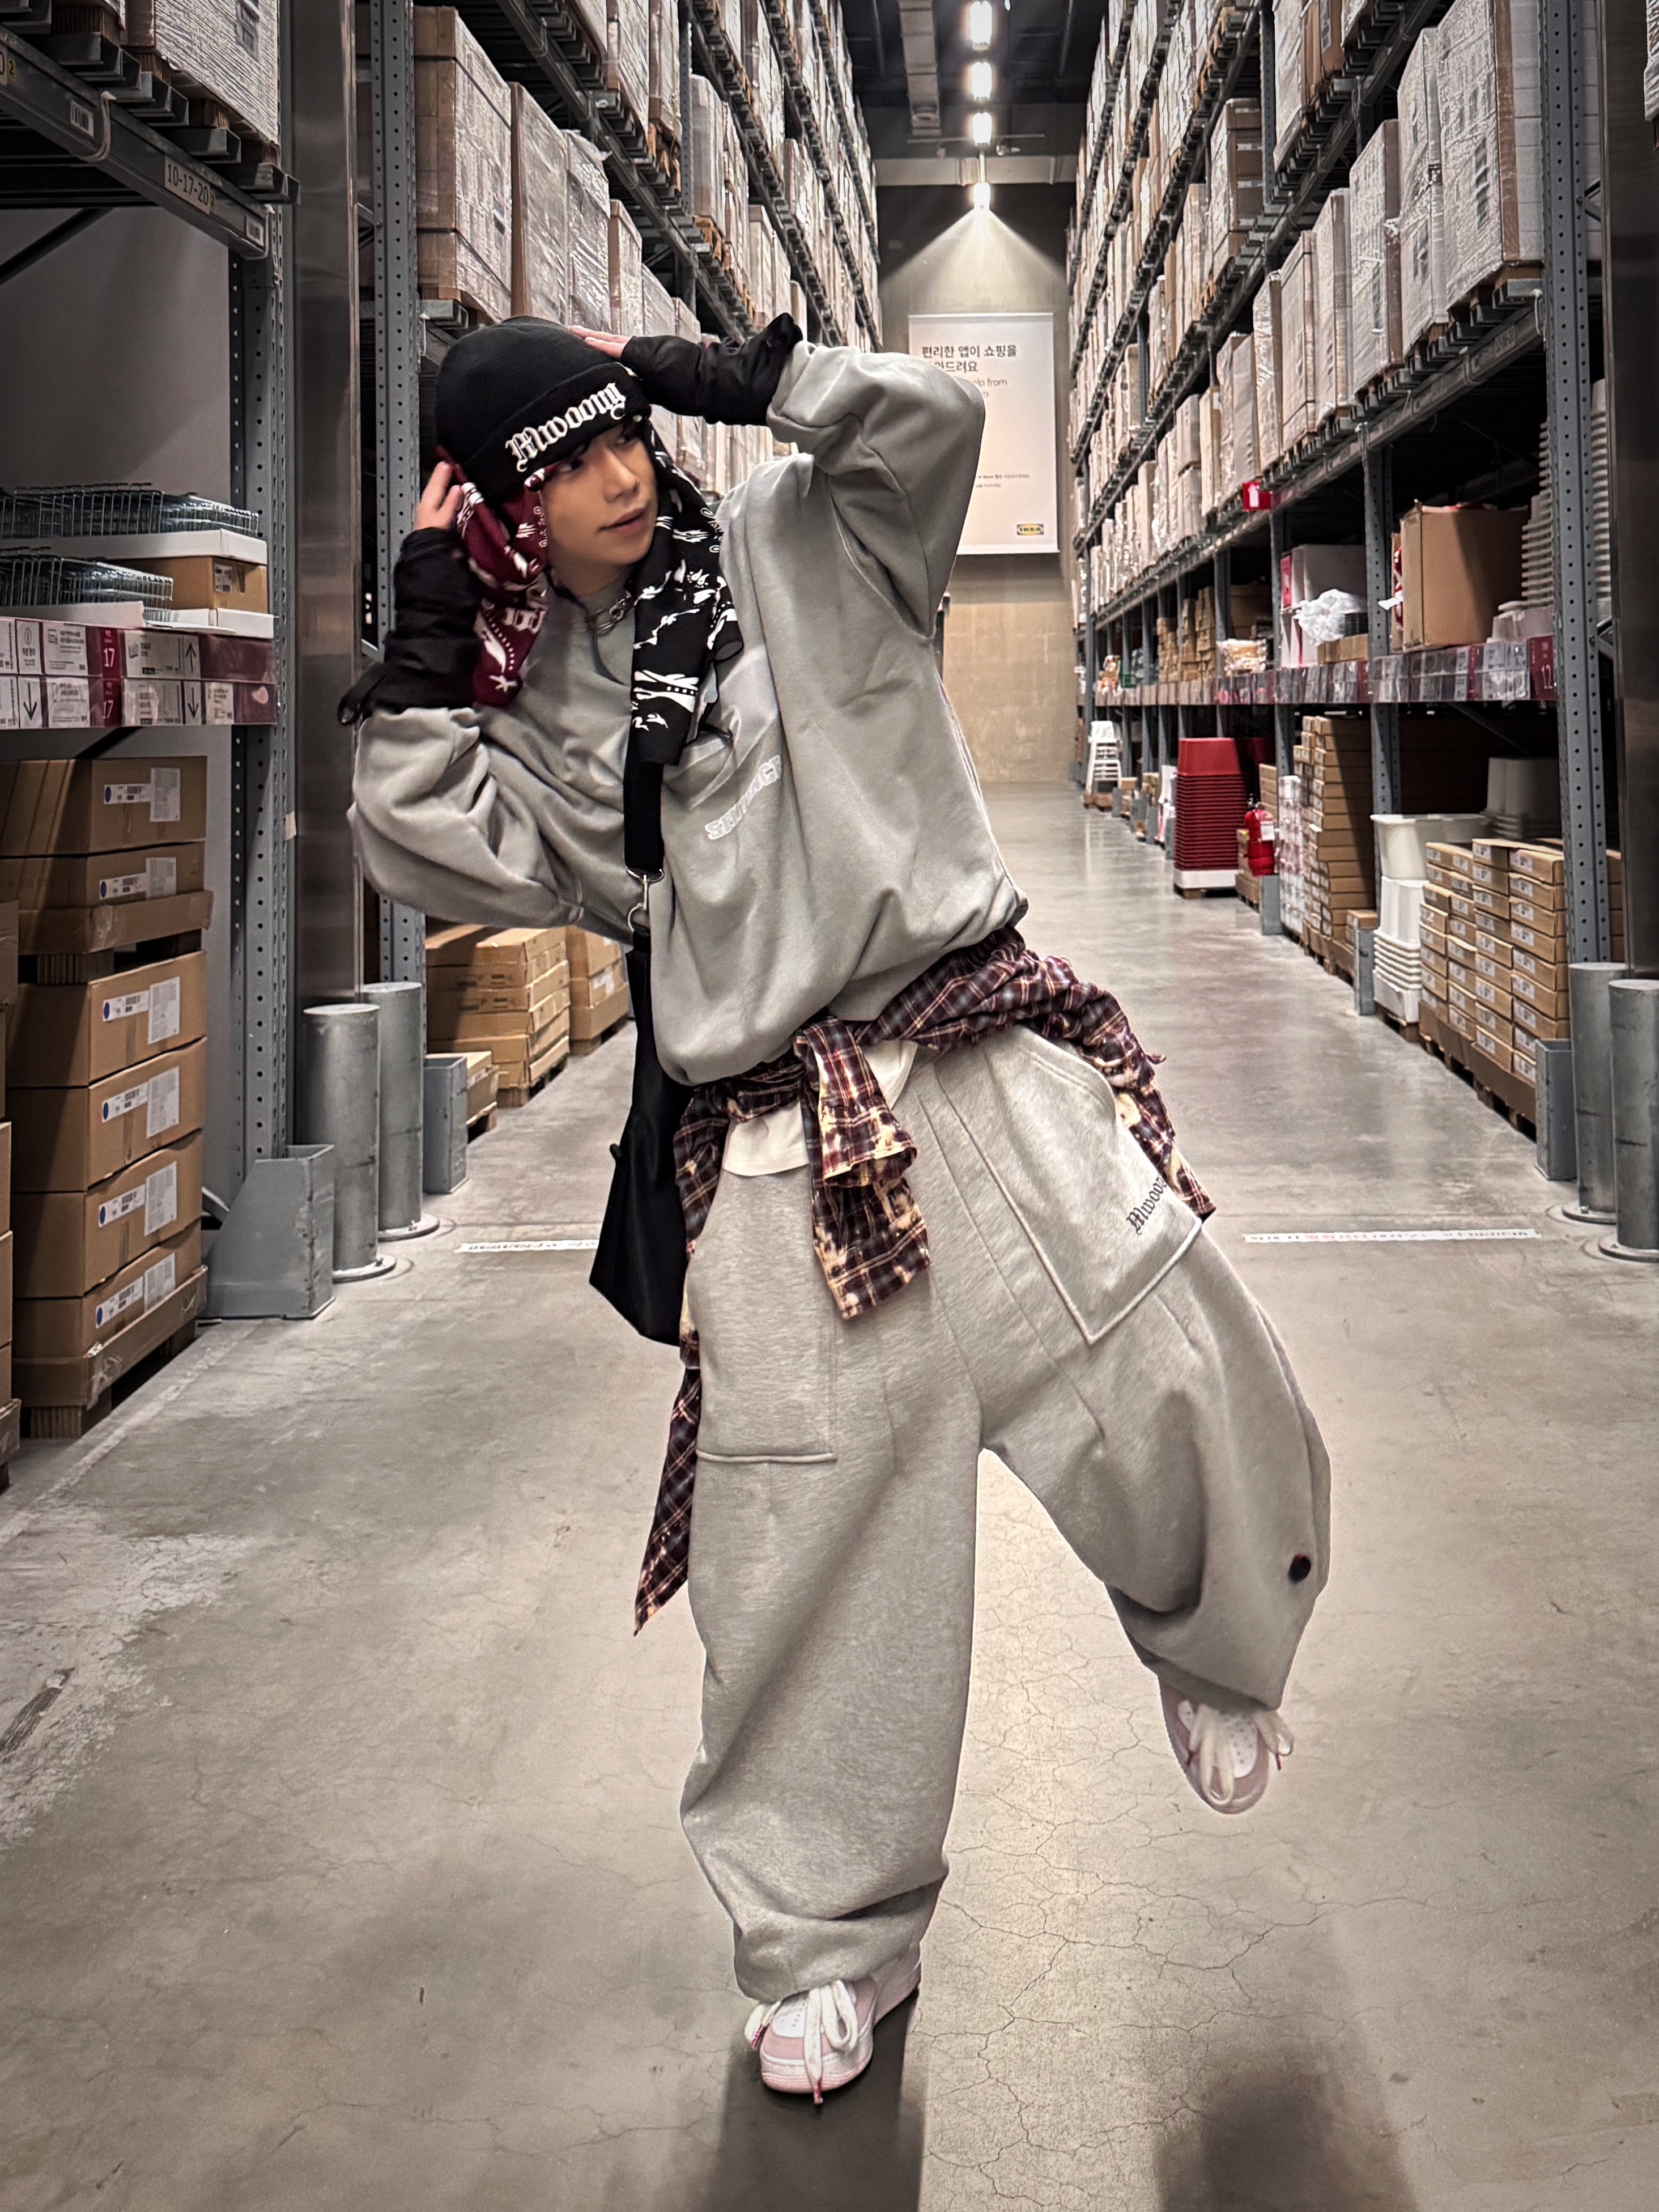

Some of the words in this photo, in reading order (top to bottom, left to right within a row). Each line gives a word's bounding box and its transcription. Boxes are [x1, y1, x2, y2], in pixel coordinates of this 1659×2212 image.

[168, 164, 209, 206] 10-17-20
[922, 345, 954, 358] 편리한
[958, 345, 980, 358] 앱이
[984, 345, 1018, 358] 쇼핑을
[987, 378, 1008, 387] from
[104, 647, 115, 668] 17
[1541, 664, 1554, 689] 12
[102, 700, 114, 720] 17
